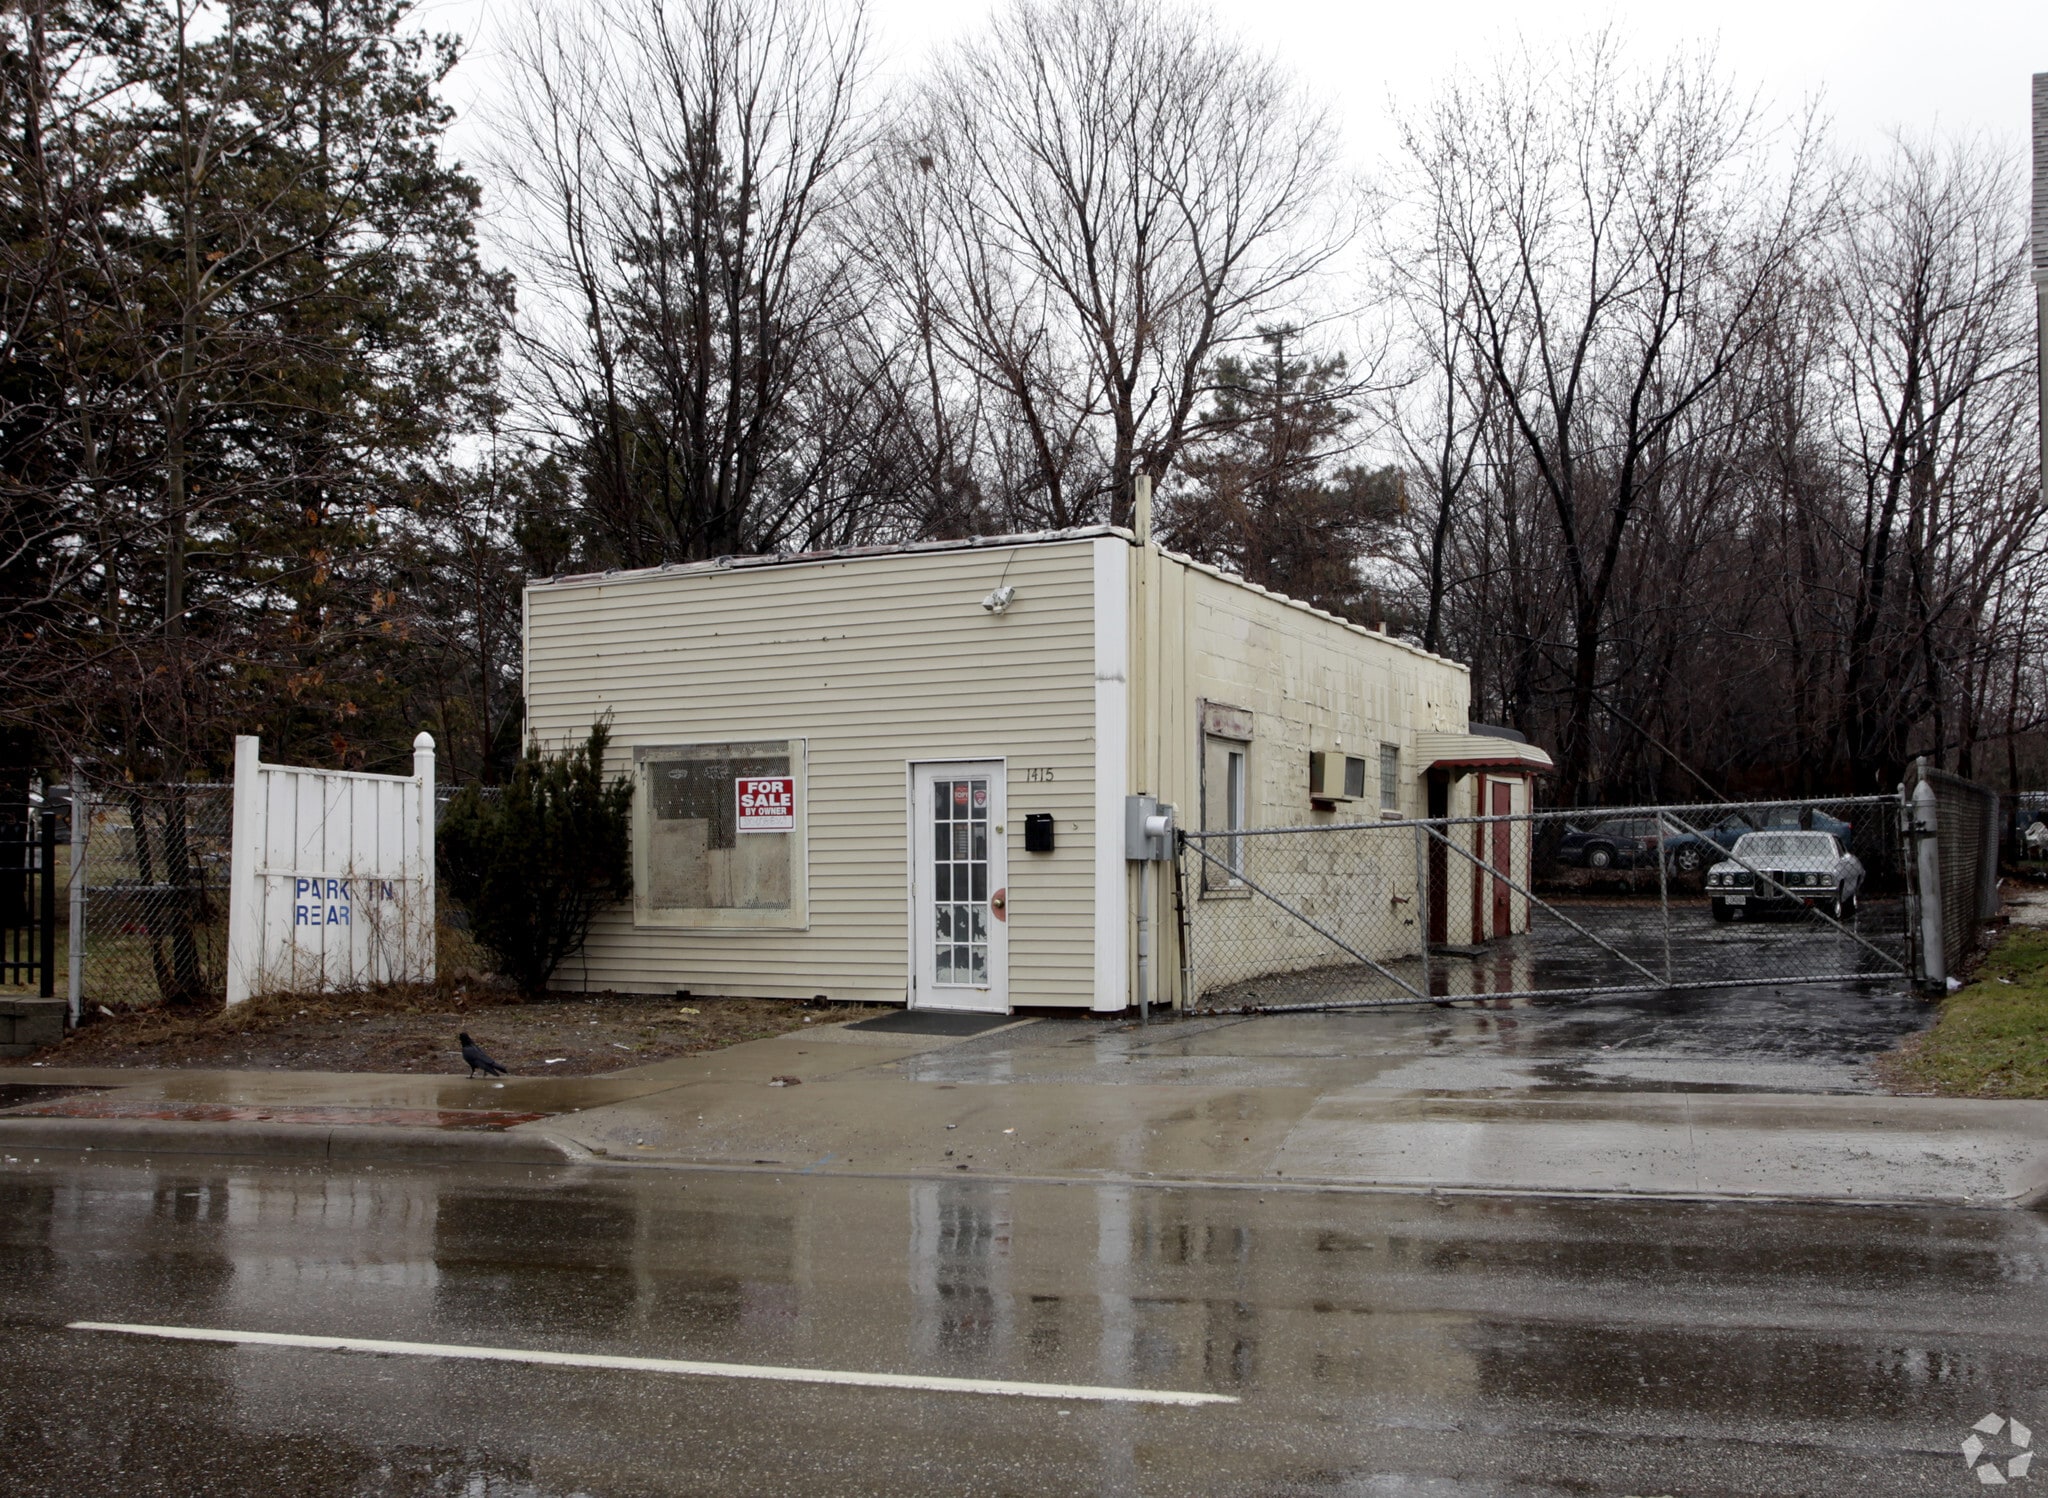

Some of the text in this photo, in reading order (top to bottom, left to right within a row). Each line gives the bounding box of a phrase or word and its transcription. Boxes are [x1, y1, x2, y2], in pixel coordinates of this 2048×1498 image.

[1026, 767, 1054, 782] 1415
[748, 781, 784, 793] FOR
[741, 794, 791, 807] SALE
[759, 807, 786, 815] OWNER
[296, 879, 393, 901] PARK IN
[296, 905, 350, 925] REAR
